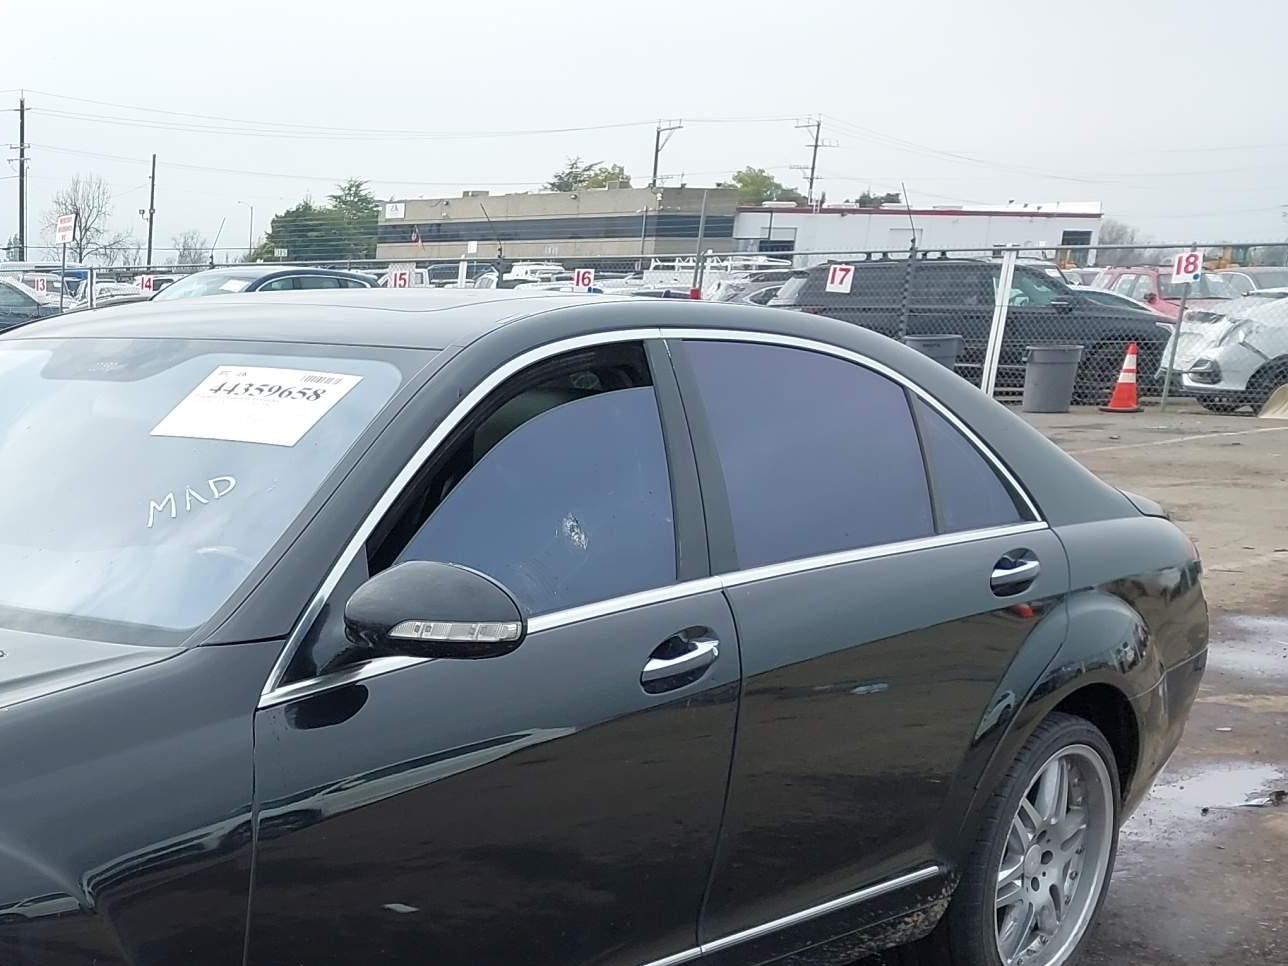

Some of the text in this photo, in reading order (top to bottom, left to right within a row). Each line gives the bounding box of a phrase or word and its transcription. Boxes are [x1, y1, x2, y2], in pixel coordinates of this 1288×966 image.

[1176, 254, 1199, 275] 18
[35, 278, 46, 291] 13
[141, 277, 152, 290] 14
[393, 272, 407, 288] 15
[576, 270, 592, 287] 16
[830, 267, 850, 285] 17
[210, 382, 326, 401] 44359658
[146, 476, 236, 528] MAD
